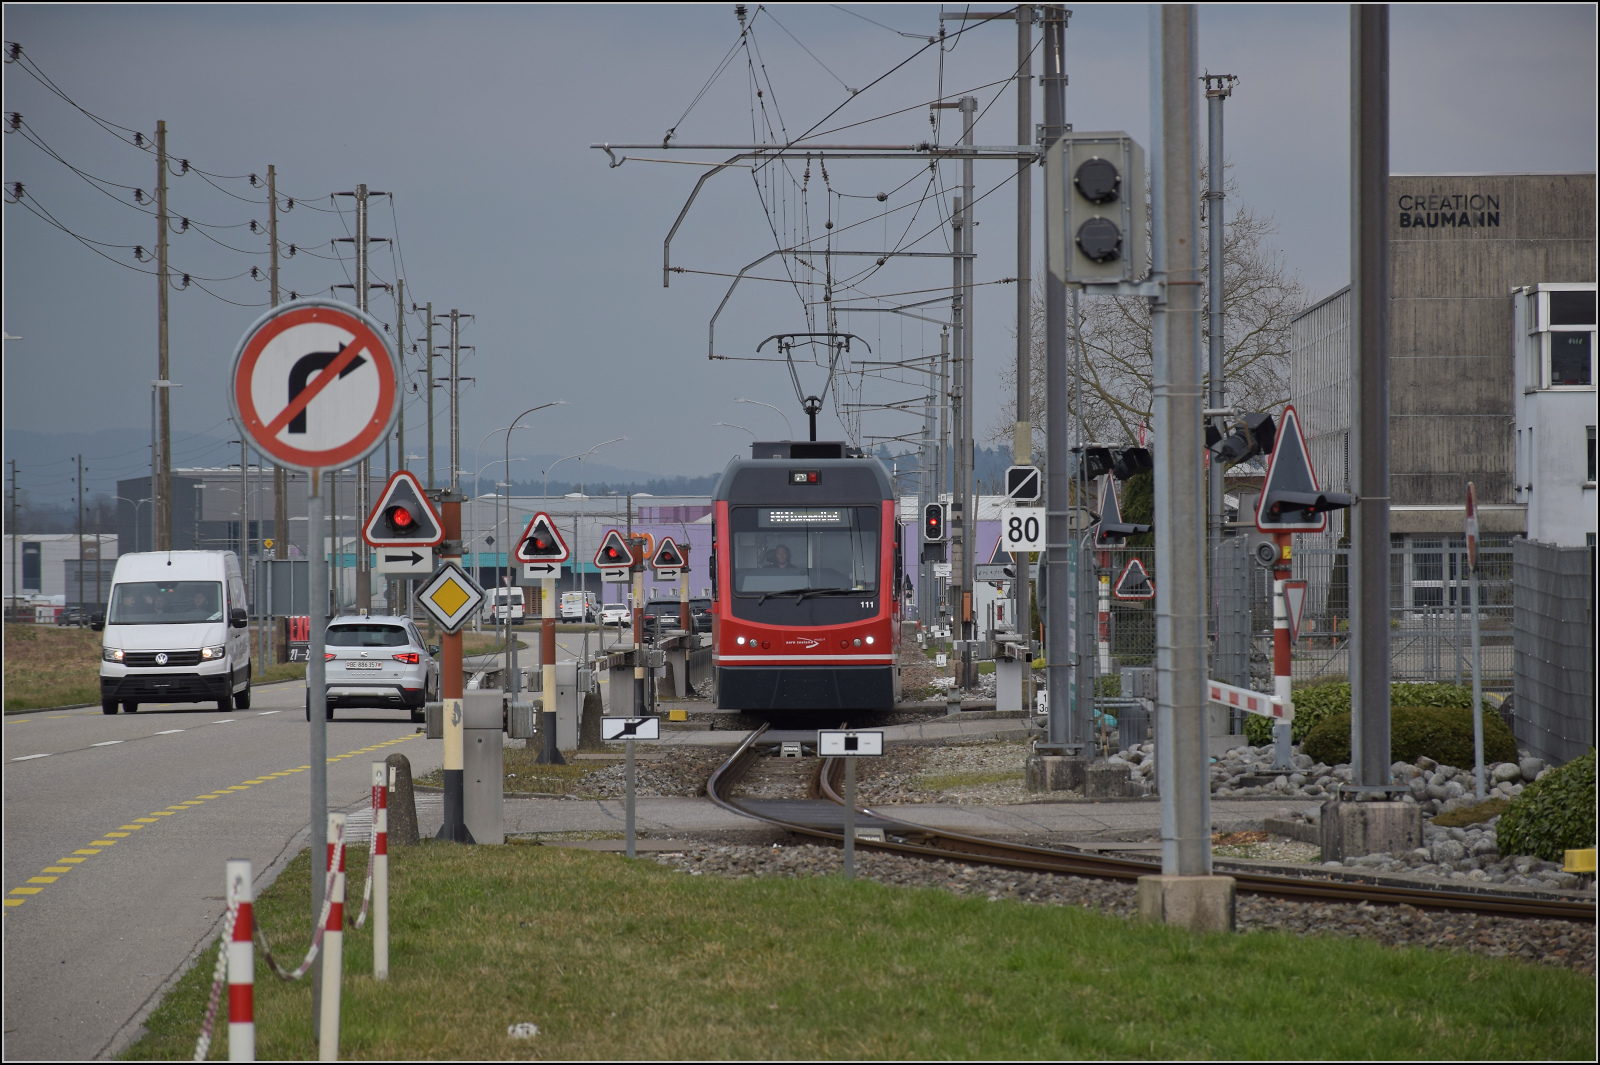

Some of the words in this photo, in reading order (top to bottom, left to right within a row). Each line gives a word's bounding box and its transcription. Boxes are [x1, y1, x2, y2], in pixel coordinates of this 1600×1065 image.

[1400, 211, 1500, 228] BAUMANN
[1008, 516, 1040, 543] 80
[860, 601, 874, 609] 111
[289, 616, 311, 642] EXP
